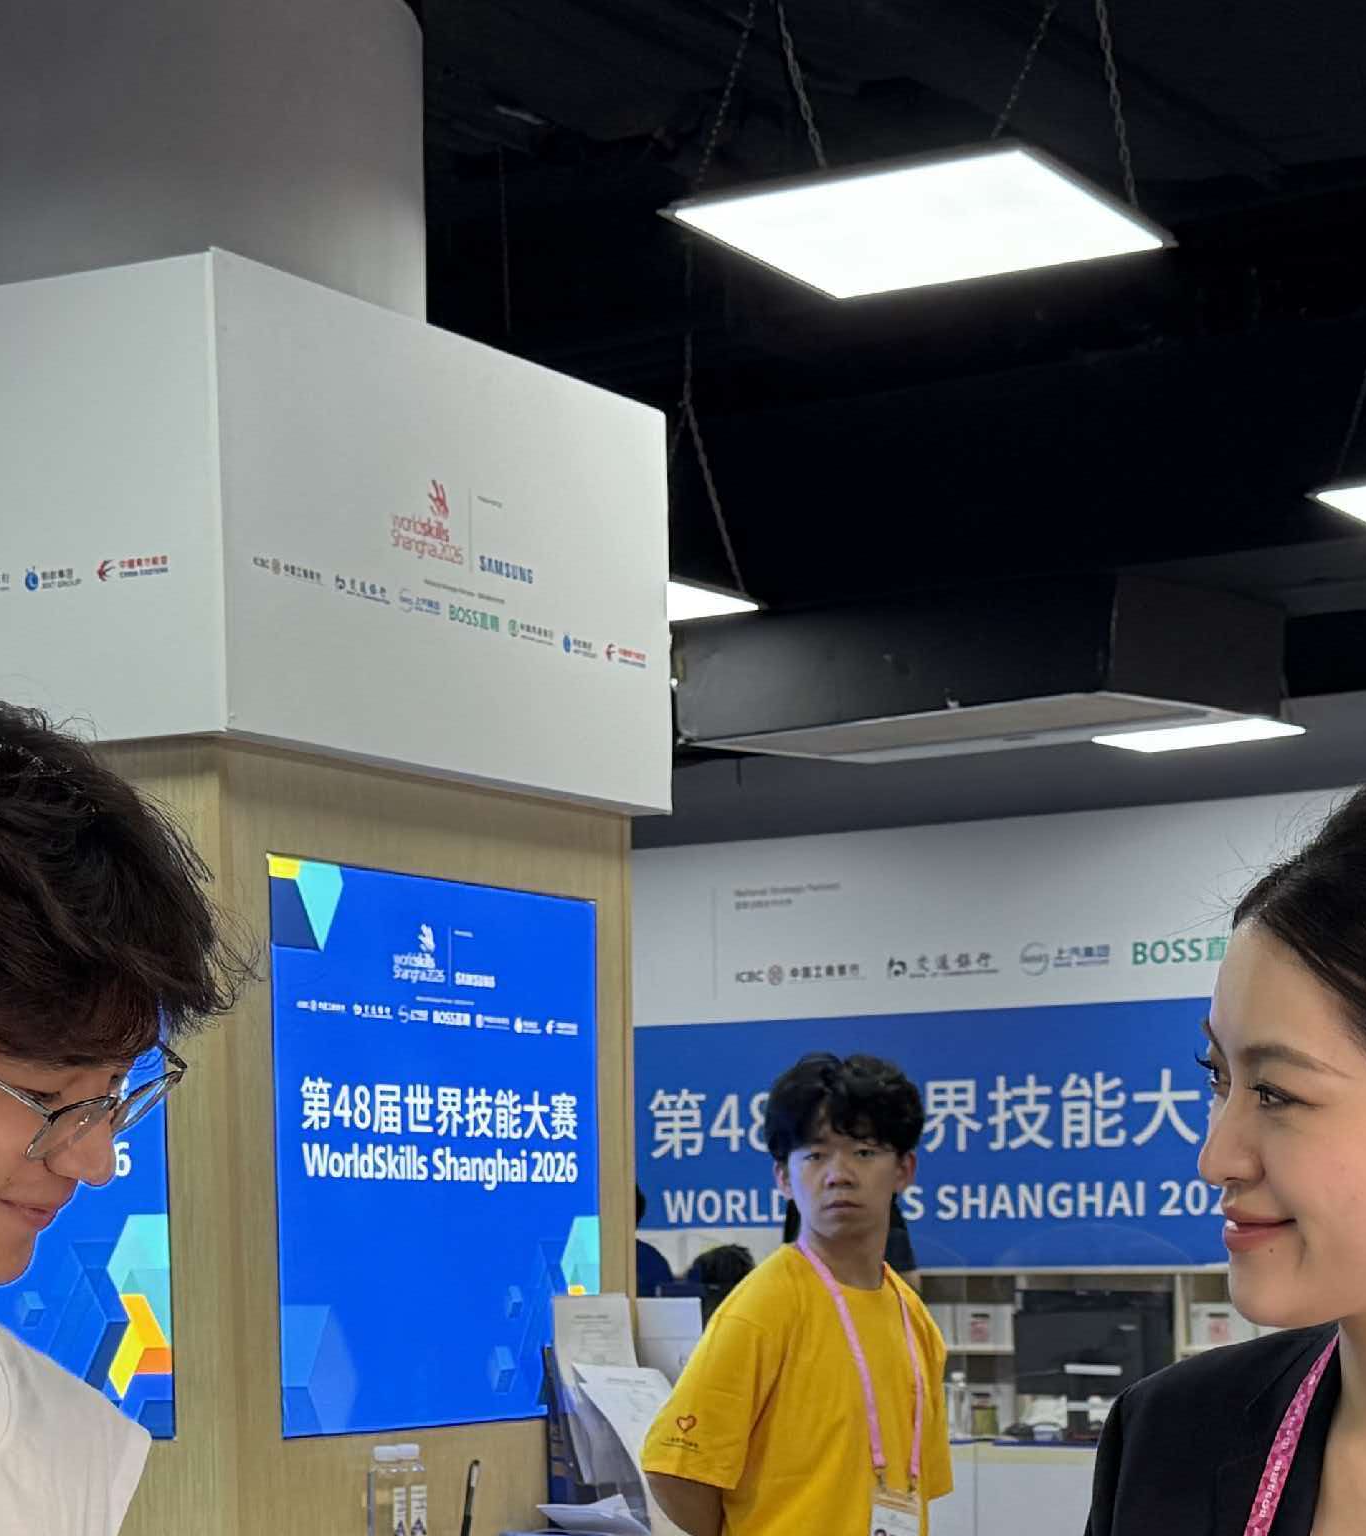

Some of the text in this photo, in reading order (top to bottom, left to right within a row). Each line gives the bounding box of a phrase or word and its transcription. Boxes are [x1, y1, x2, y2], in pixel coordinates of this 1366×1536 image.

[479, 555, 533, 584] SAMSUNG
[1132, 936, 1228, 966] BOSS直
[300, 1076, 578, 1141] 第48届世界技能大赛
[302, 1141, 579, 1191] WorldSkills Shanghai 2026
[937, 1180, 1146, 1221] SHANGHAI
[1158, 1179, 1225, 1217] 202
